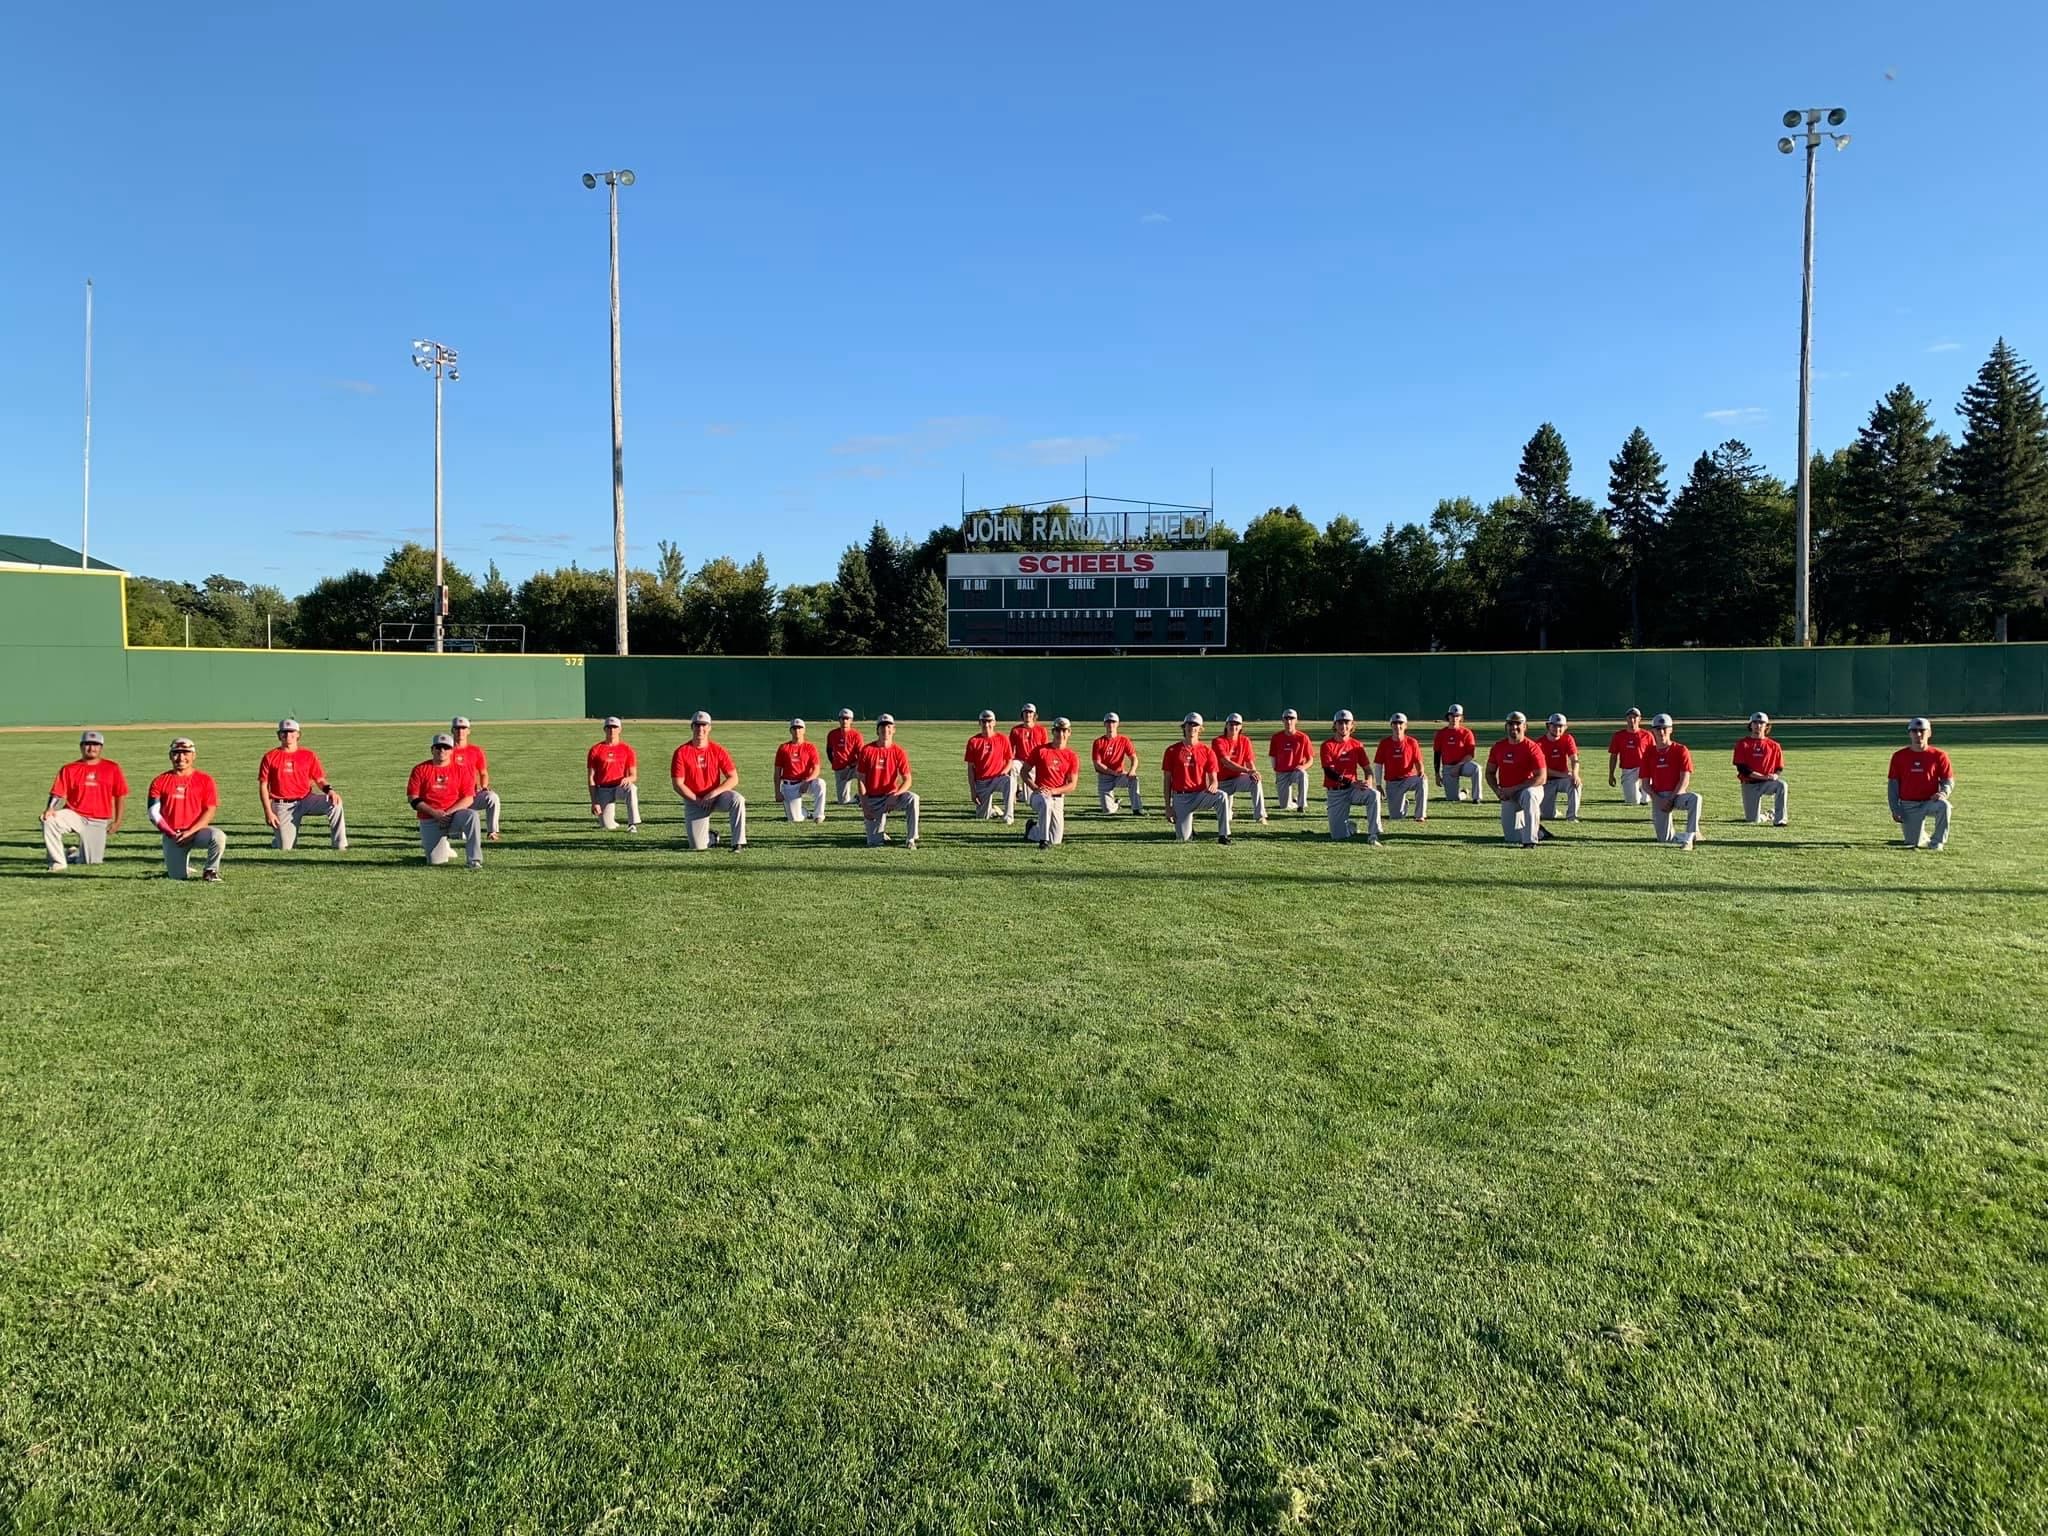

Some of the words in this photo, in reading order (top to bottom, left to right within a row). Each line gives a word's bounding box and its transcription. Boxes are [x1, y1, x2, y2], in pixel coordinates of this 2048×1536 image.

[967, 517, 1021, 542] JOHN
[1033, 516, 1138, 541] RANDALL
[1149, 514, 1208, 540] FIELD
[1018, 554, 1154, 573] SCHEELS
[963, 580, 971, 590] AT
[975, 580, 987, 590] BAT
[1017, 580, 1034, 590] BALL
[1068, 579, 1096, 589] STRIKE
[1134, 578, 1149, 589] OUT
[1205, 577, 1211, 588] E
[565, 658, 583, 666] 372
